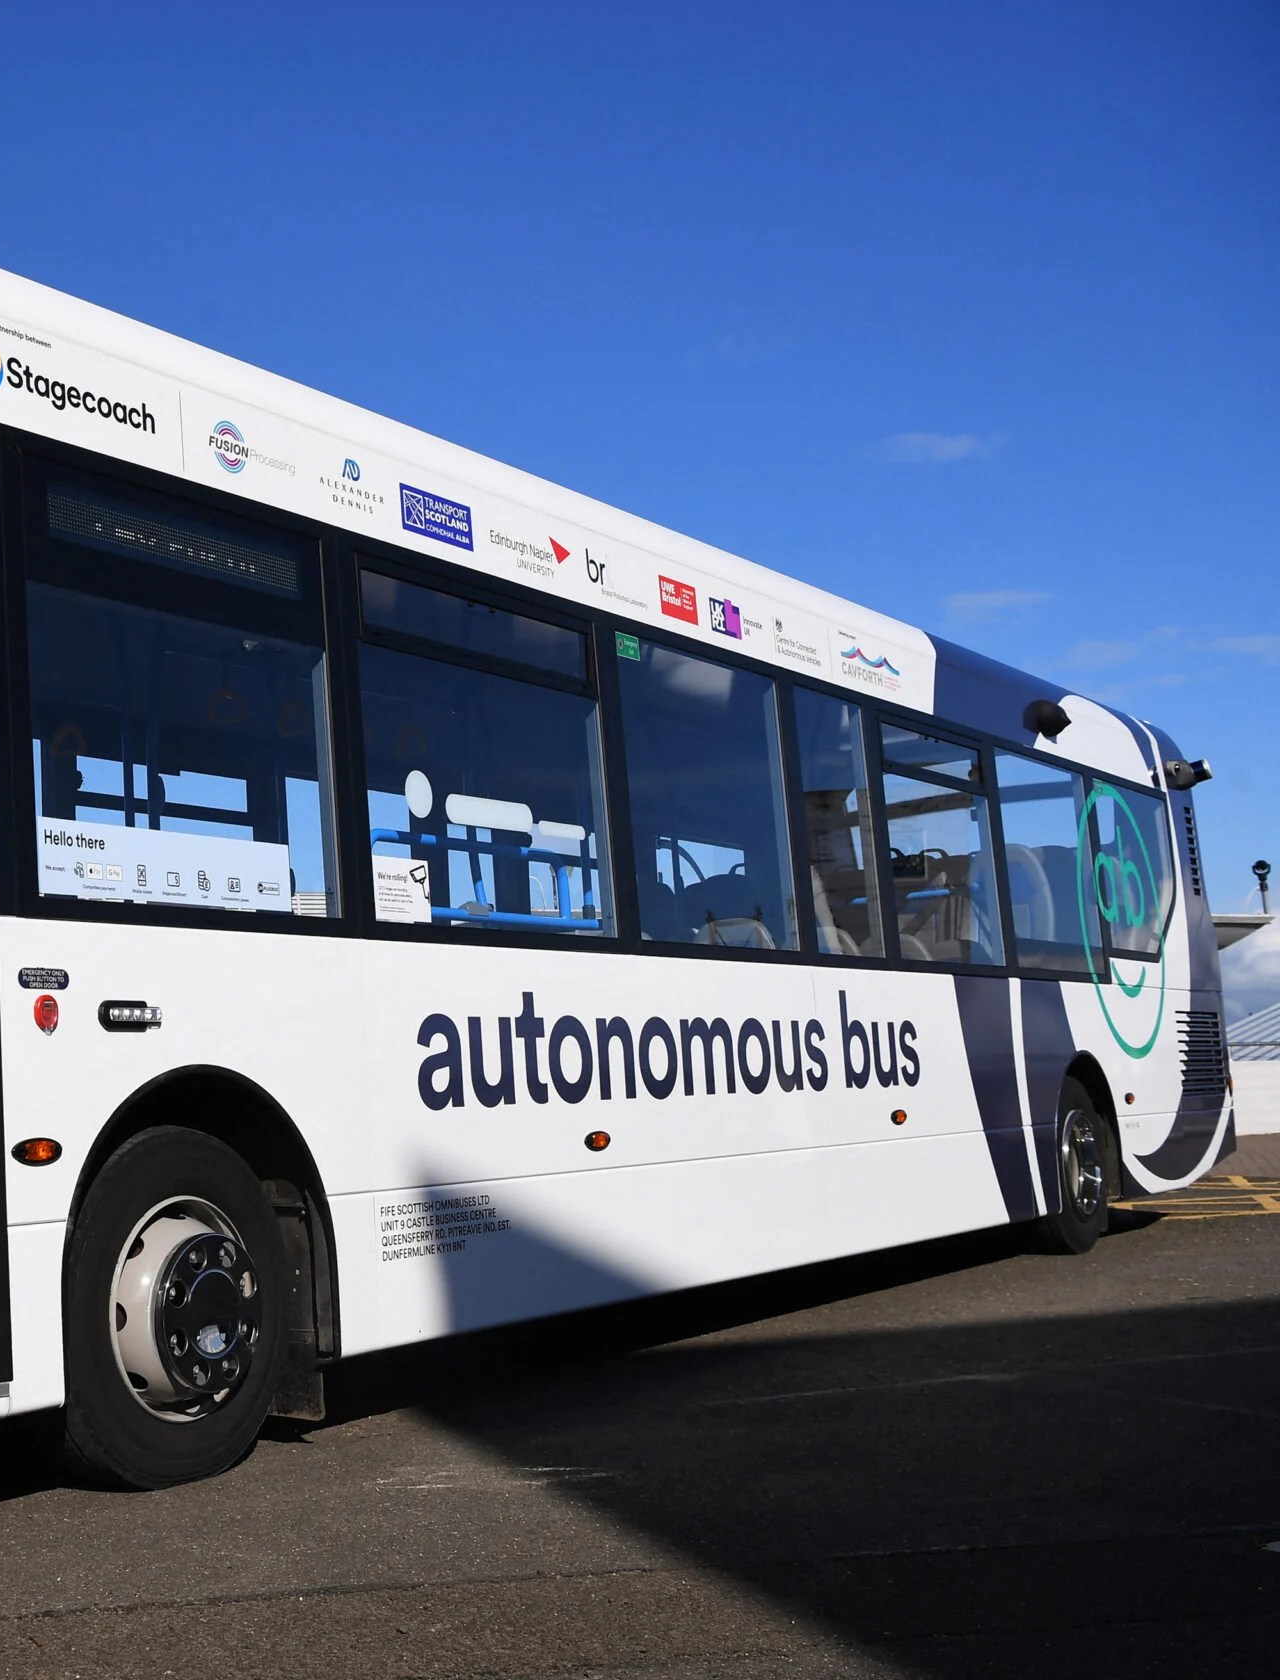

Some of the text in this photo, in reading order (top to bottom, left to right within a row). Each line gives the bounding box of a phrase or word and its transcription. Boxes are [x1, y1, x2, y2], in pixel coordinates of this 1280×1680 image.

[25, 334, 52, 349] between
[6, 357, 156, 434] Stagecoach
[208, 435, 296, 476] FUSION Processing
[319, 476, 385, 504] ALEXANDER
[332, 494, 374, 514] DENNIS
[424, 497, 468, 521] TRANSPORT
[425, 509, 469, 533] SCOTLAND
[455, 535, 470, 545] ALBA
[490, 529, 554, 563] Edinburgh Napier
[517, 558, 555, 578] UNIVERSITY
[661, 580, 676, 595] UWE
[661, 591, 682, 607] Bristol
[743, 616, 763, 630] Innovate
[841, 662, 883, 687] CAVFORTH
[44, 829, 105, 850] Hello there
[417, 989, 920, 1111] autonomous bus
[380, 1194, 490, 1217] FIFE SCOTTISH OMNIBUSES LTD
[381, 1208, 497, 1232] UNIT 9 CASTLE BUSINESS CENTRE
[381, 1219, 512, 1247] QUEENSFERRY RD. PITREAVIE IND. EST.
[382, 1244, 436, 1262] DUNFERMLINE
